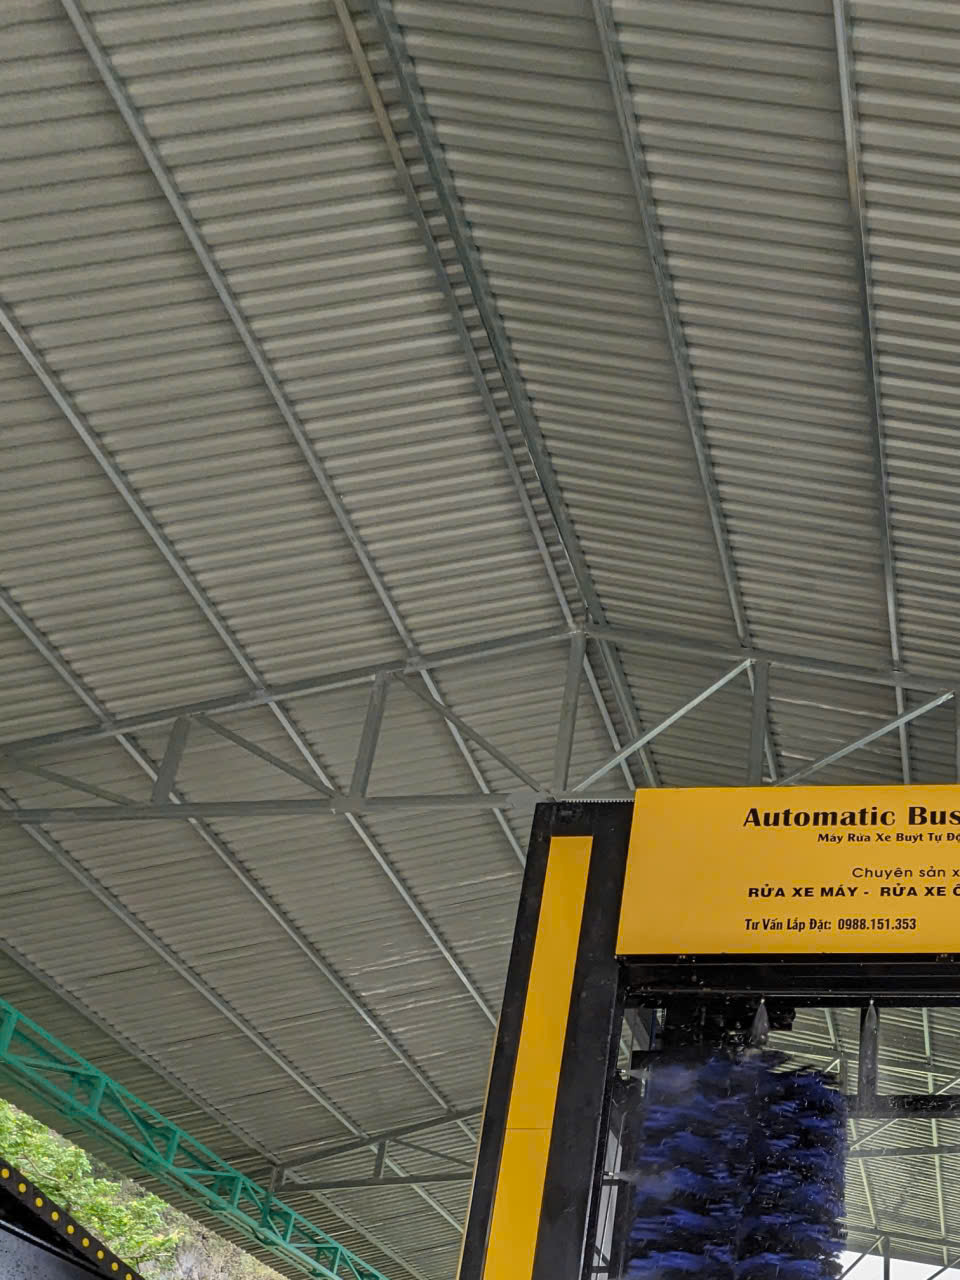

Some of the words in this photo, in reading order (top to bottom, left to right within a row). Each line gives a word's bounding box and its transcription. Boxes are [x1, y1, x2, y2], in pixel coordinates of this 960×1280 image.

[743, 806, 896, 827] Automatic
[818, 833, 843, 844] Máy
[875, 832, 891, 842] Xe
[896, 832, 924, 843] Buýt
[928, 832, 943, 843] Tự
[852, 867, 913, 880] Chuyên
[919, 866, 946, 878] sản
[748, 884, 785, 897] RỬA
[792, 887, 814, 897] XE
[820, 885, 858, 896] MÁY
[880, 883, 918, 897] RỬA
[924, 886, 946, 896] XE
[745, 918, 760, 930] Tư
[809, 918, 832, 932] Đặt:
[837, 918, 917, 930] 0988.151.353
